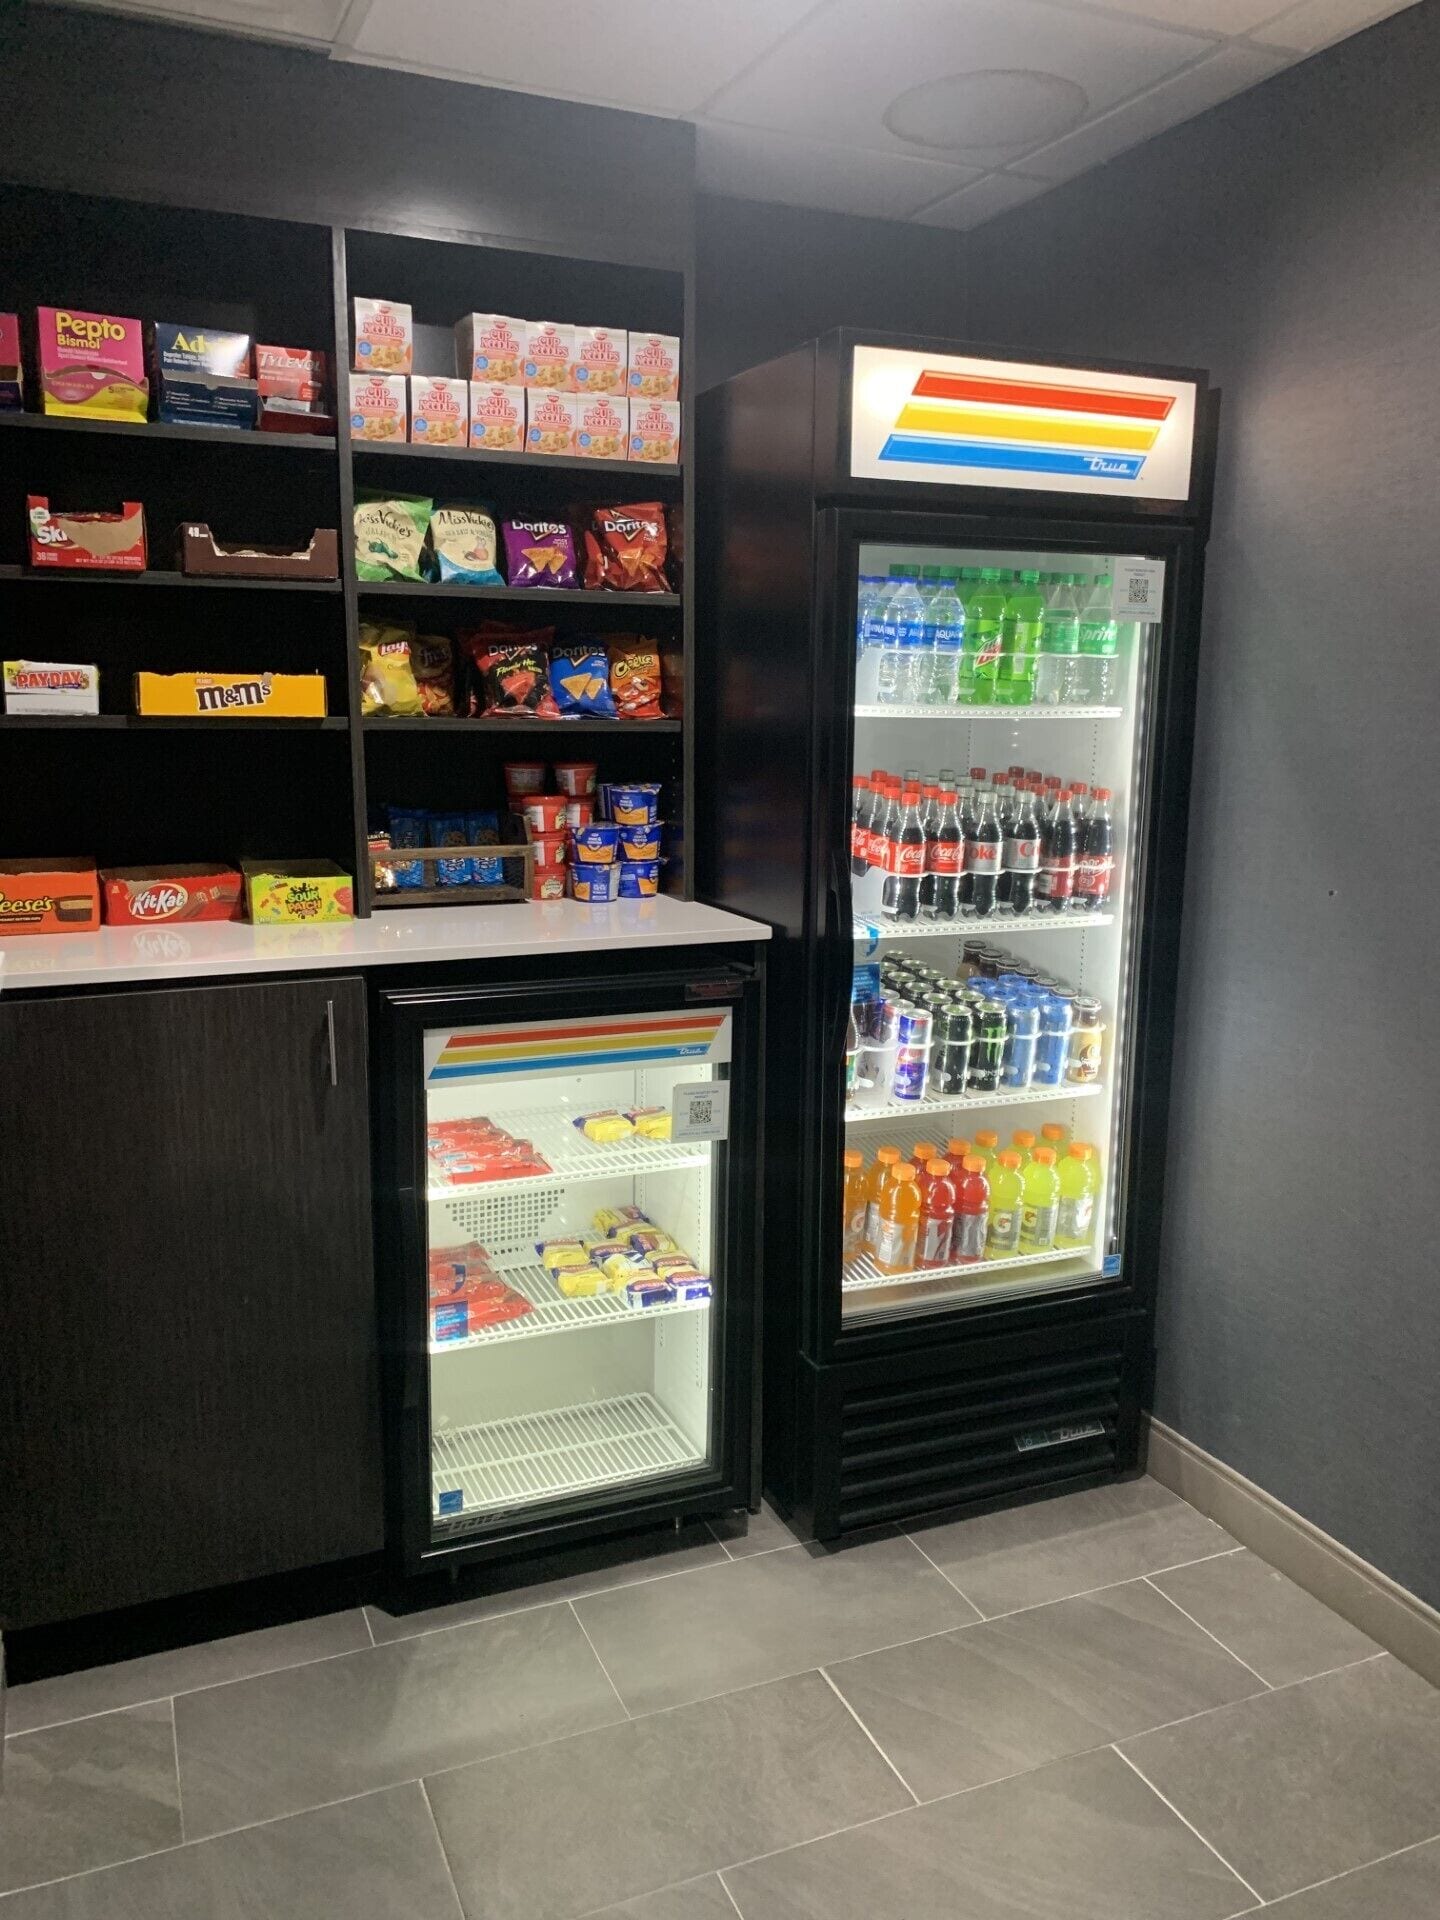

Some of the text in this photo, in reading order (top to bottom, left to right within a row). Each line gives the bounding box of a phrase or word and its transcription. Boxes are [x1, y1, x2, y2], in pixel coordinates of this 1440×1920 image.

[55, 311, 126, 341] Pepto
[363, 322, 405, 338] NOODLES
[56, 333, 101, 350] Bismol
[480, 337, 519, 352] NOODLES
[529, 344, 569, 358] NOODLES
[580, 348, 620, 362] NOODLES
[635, 355, 673, 368] NOODLES
[355, 396, 398, 409] NOODLES
[419, 399, 461, 413] NOODLES
[477, 404, 517, 417] NOODLES
[534, 410, 572, 425] NOODLES
[584, 415, 621, 428] NOODLES
[637, 419, 674, 432] NOODLES
[1082, 457, 1131, 474] true
[377, 509, 414, 538] Vickie's
[511, 519, 567, 535] Doritos
[604, 520, 659, 537] Doritos
[553, 644, 606, 660] Doritos
[16, 670, 82, 689] PAYDAY
[287, 891, 320, 903] SOUR
[287, 900, 322, 912] PATCH
